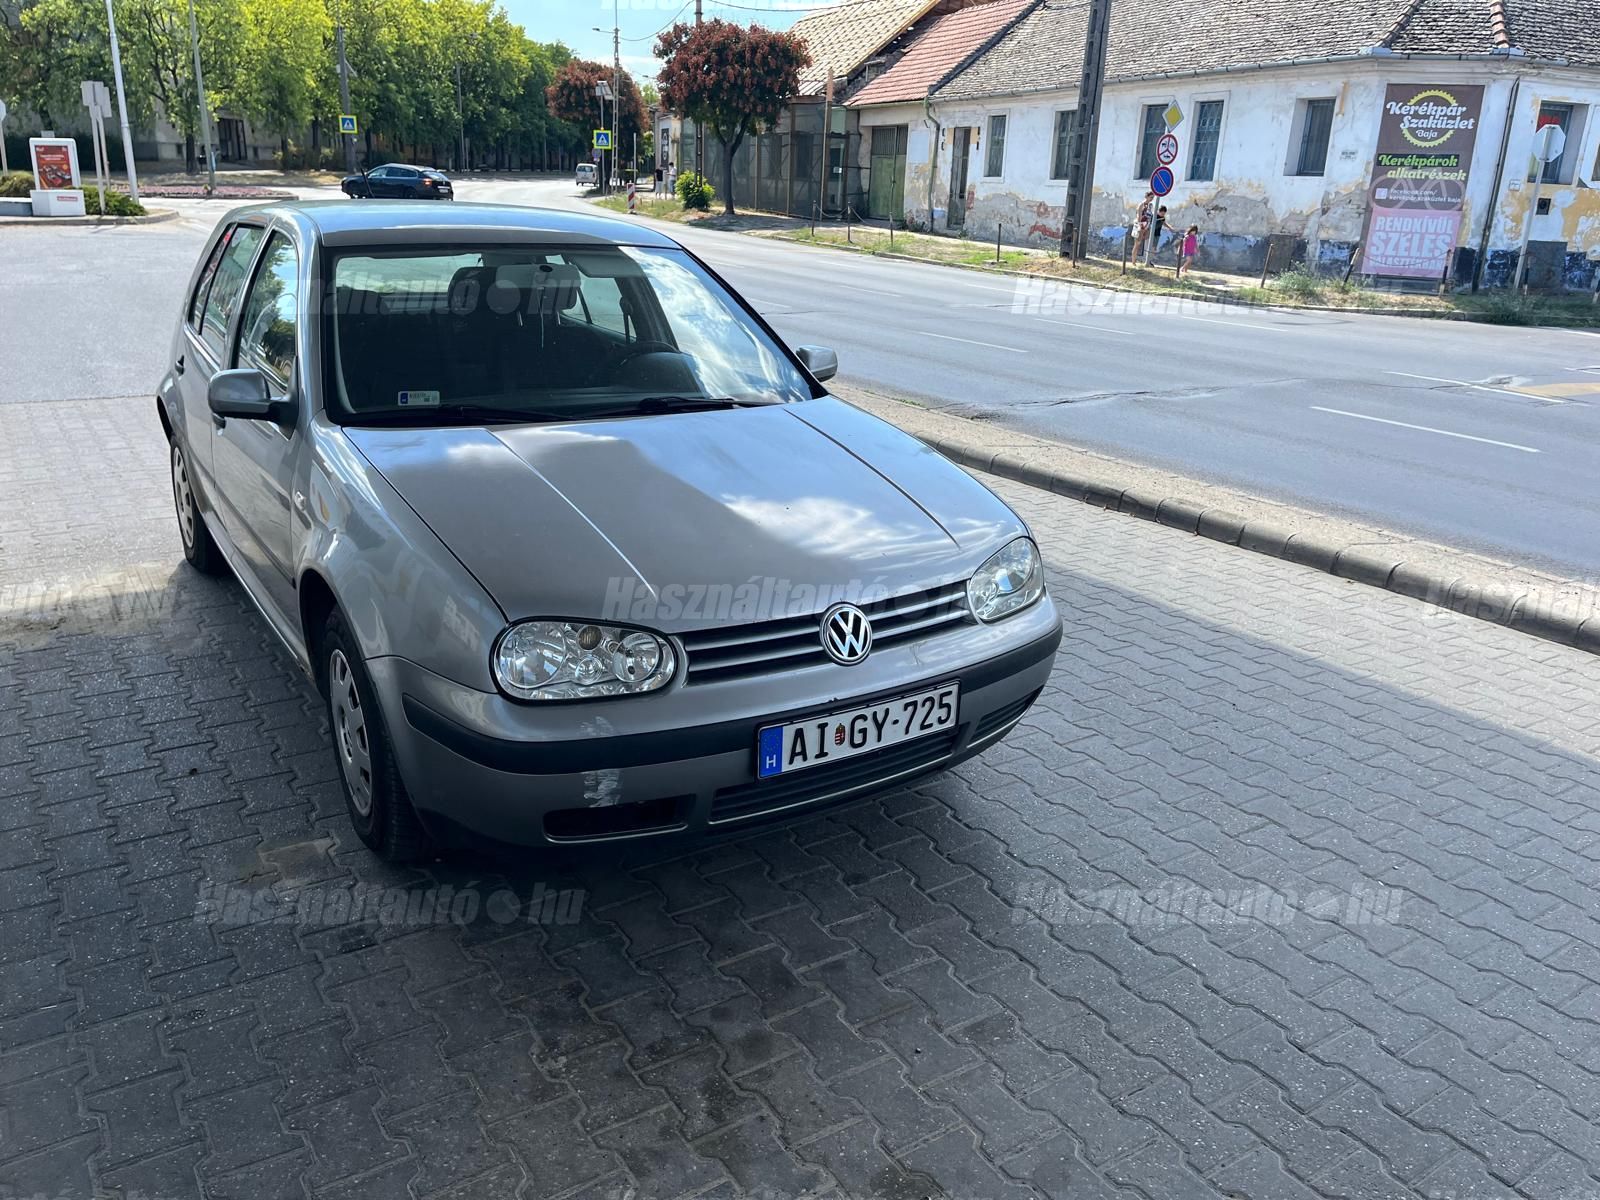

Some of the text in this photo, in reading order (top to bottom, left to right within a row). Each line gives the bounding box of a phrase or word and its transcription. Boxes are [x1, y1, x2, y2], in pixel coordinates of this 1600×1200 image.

[1386, 101, 1467, 119] Kerékpár
[1400, 115, 1475, 130] Szaküzlet
[1415, 130, 1438, 140] Baja
[1378, 154, 1458, 168] Kerékpárok
[1387, 168, 1467, 181] alkatrészek
[1375, 214, 1454, 233] RENDKÍVÜL
[1370, 232, 1452, 258] SZÉLES
[849, 691, 954, 749] GY-725
[765, 754, 777, 769] H
